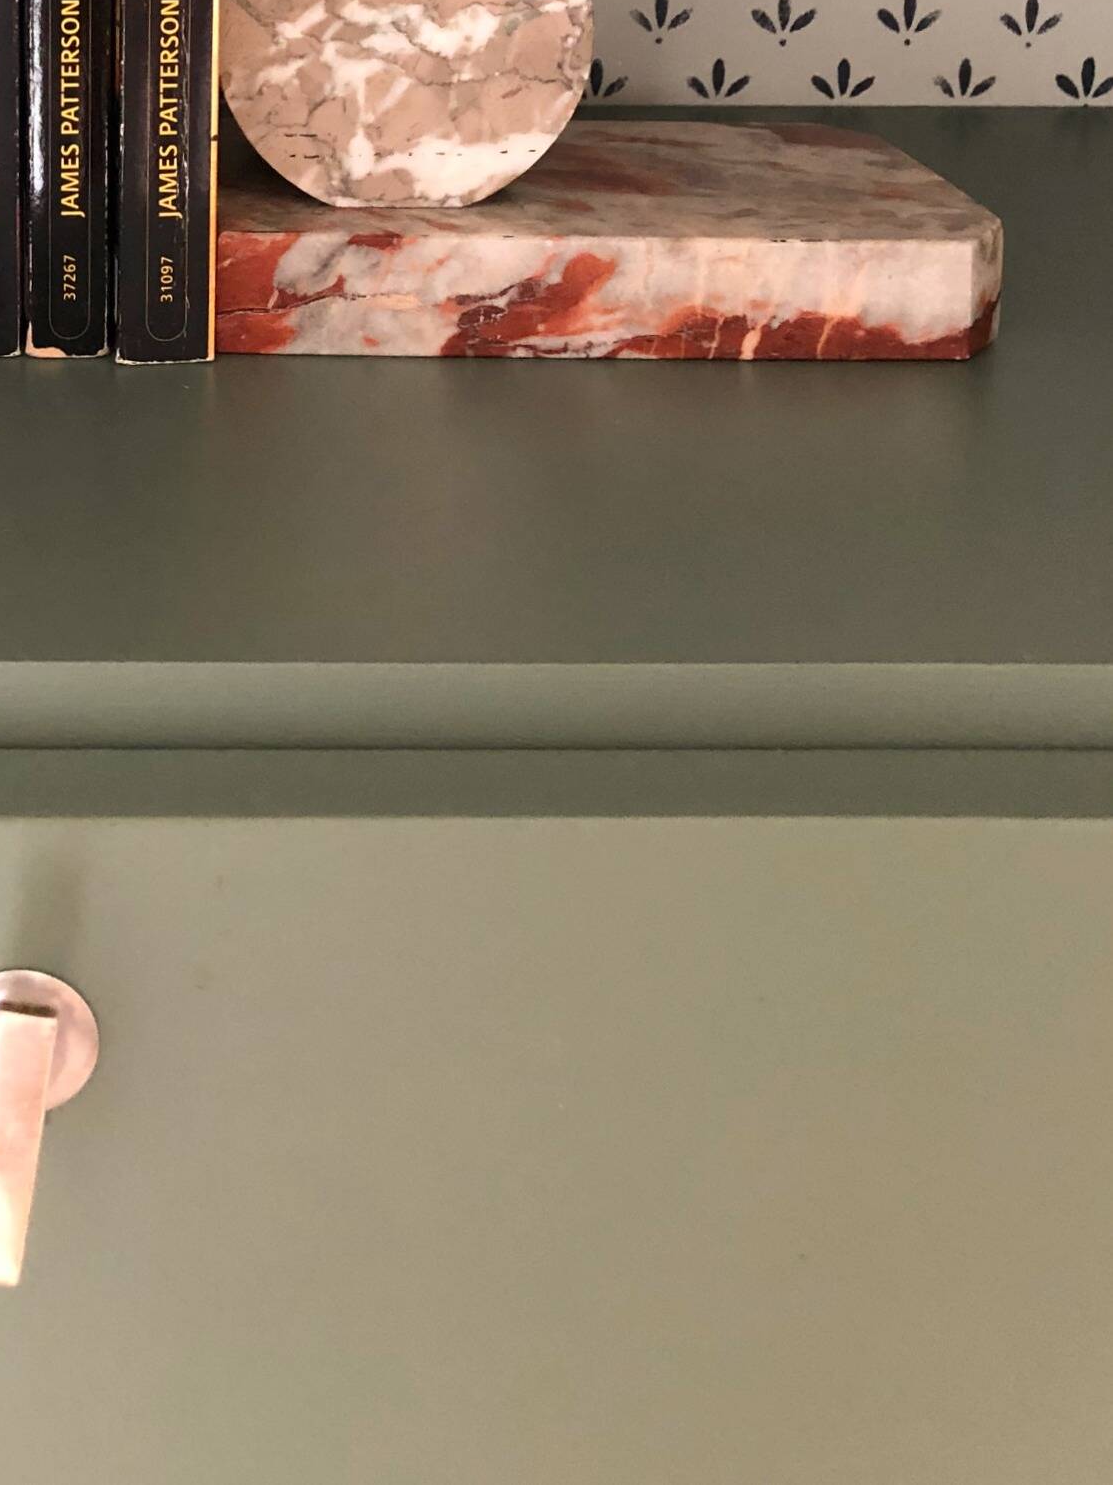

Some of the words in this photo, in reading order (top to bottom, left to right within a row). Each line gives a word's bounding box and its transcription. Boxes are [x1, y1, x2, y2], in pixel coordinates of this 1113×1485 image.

[60, 0, 80, 135] PATTERSON
[158, 0, 179, 136] PATTERSON
[60, 143, 85, 217] JAMES
[158, 144, 182, 218] JAMES
[63, 255, 76, 300] 37267
[160, 256, 174, 302] 31097
